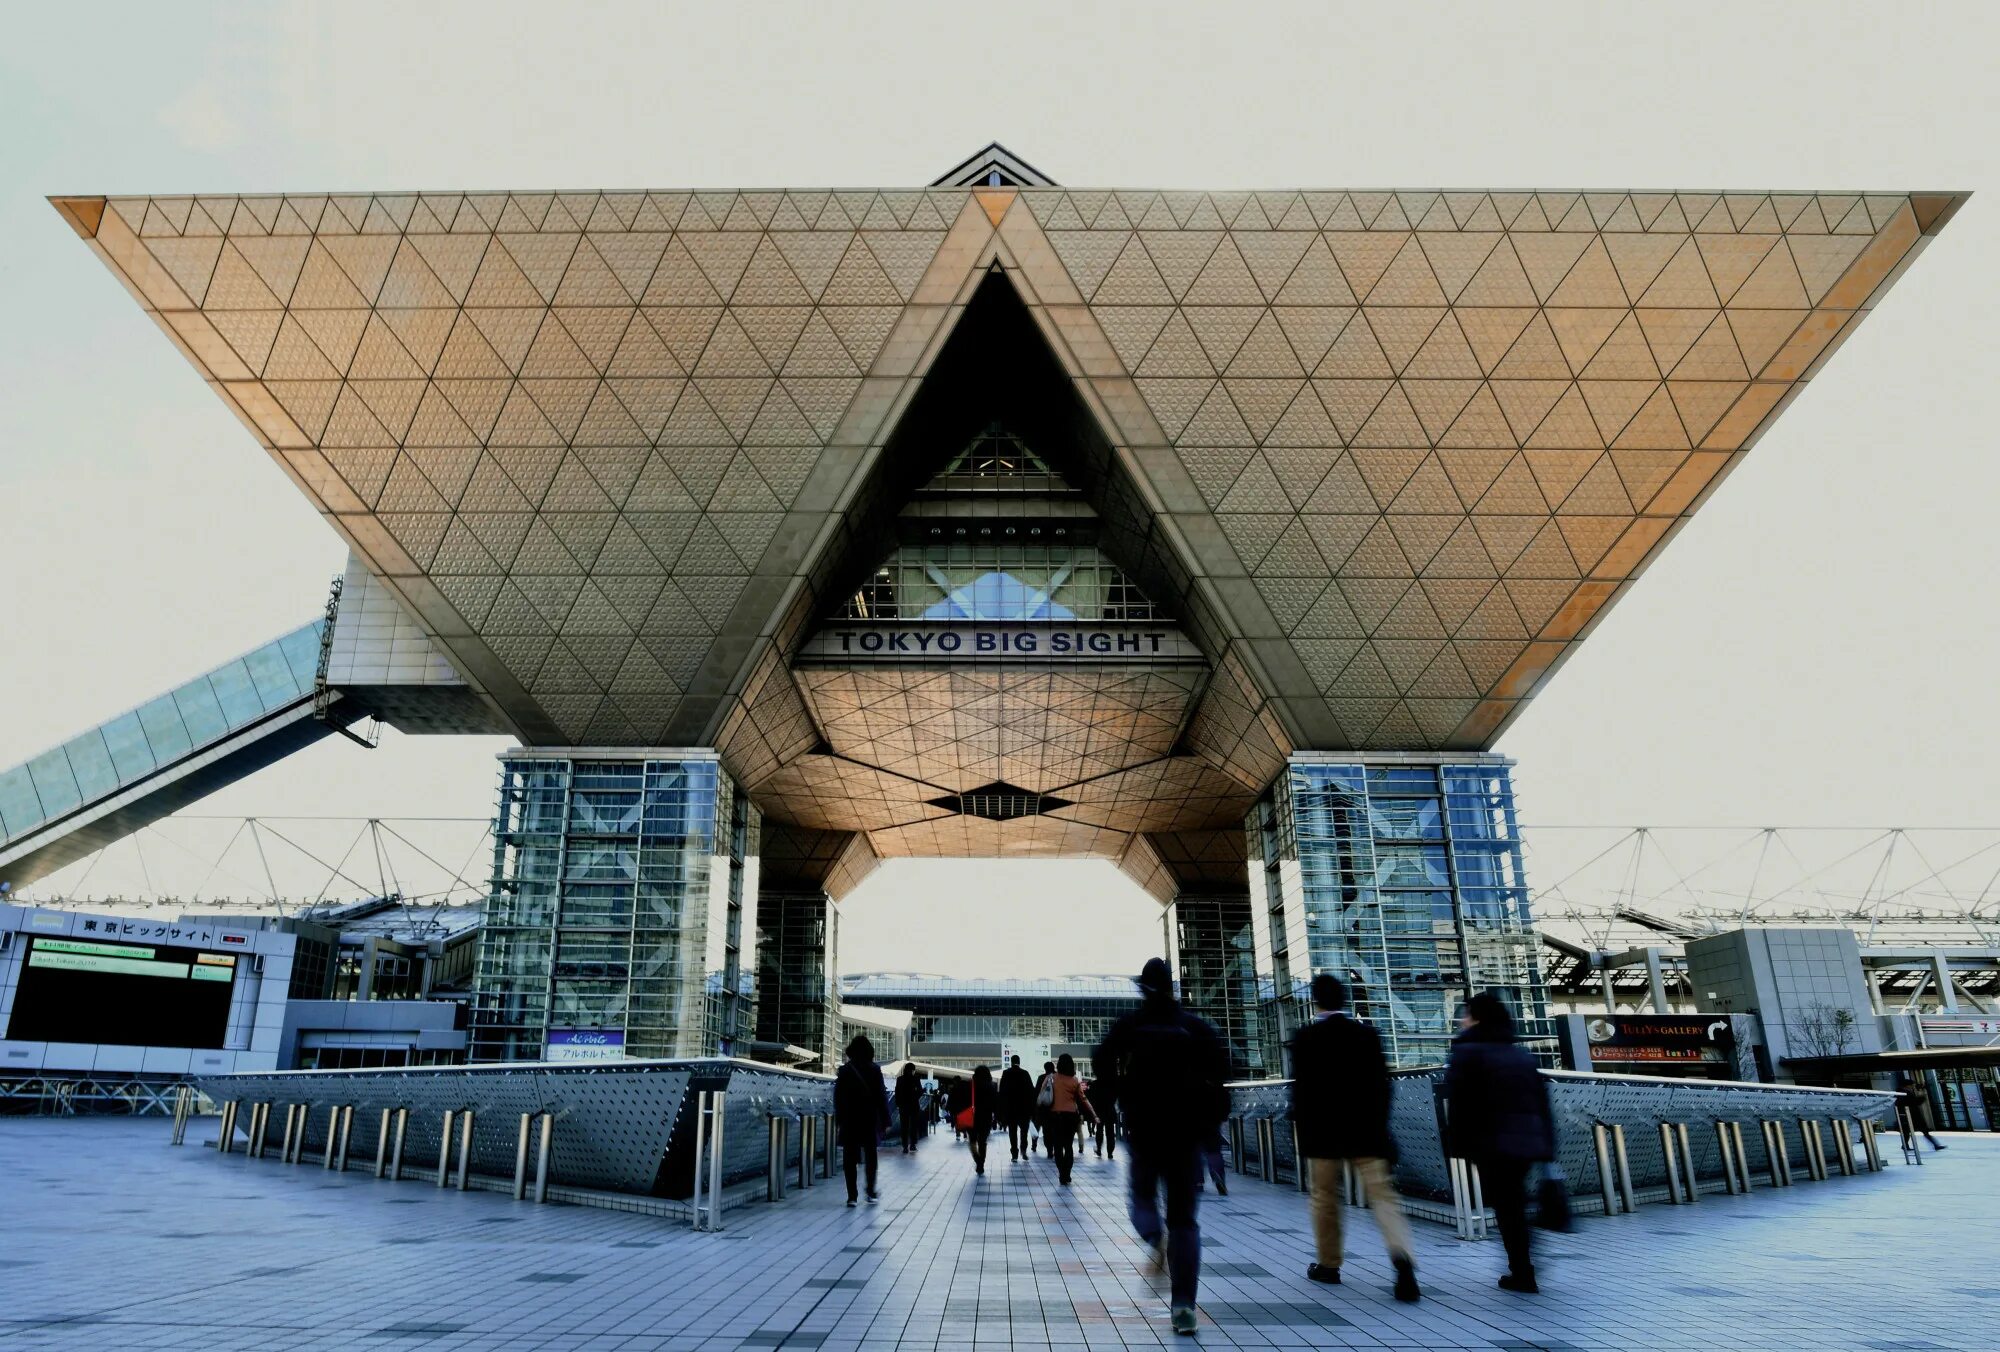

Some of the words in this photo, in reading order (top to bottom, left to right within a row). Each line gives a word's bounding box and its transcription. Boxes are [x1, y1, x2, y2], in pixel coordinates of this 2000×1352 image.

[835, 631, 961, 652] TOKYO
[976, 631, 1037, 652] BIG
[1051, 631, 1166, 652] SIGHT
[84, 919, 211, 942] 東京ビッグサイト
[1660, 1025, 1705, 1035] GALLERY
